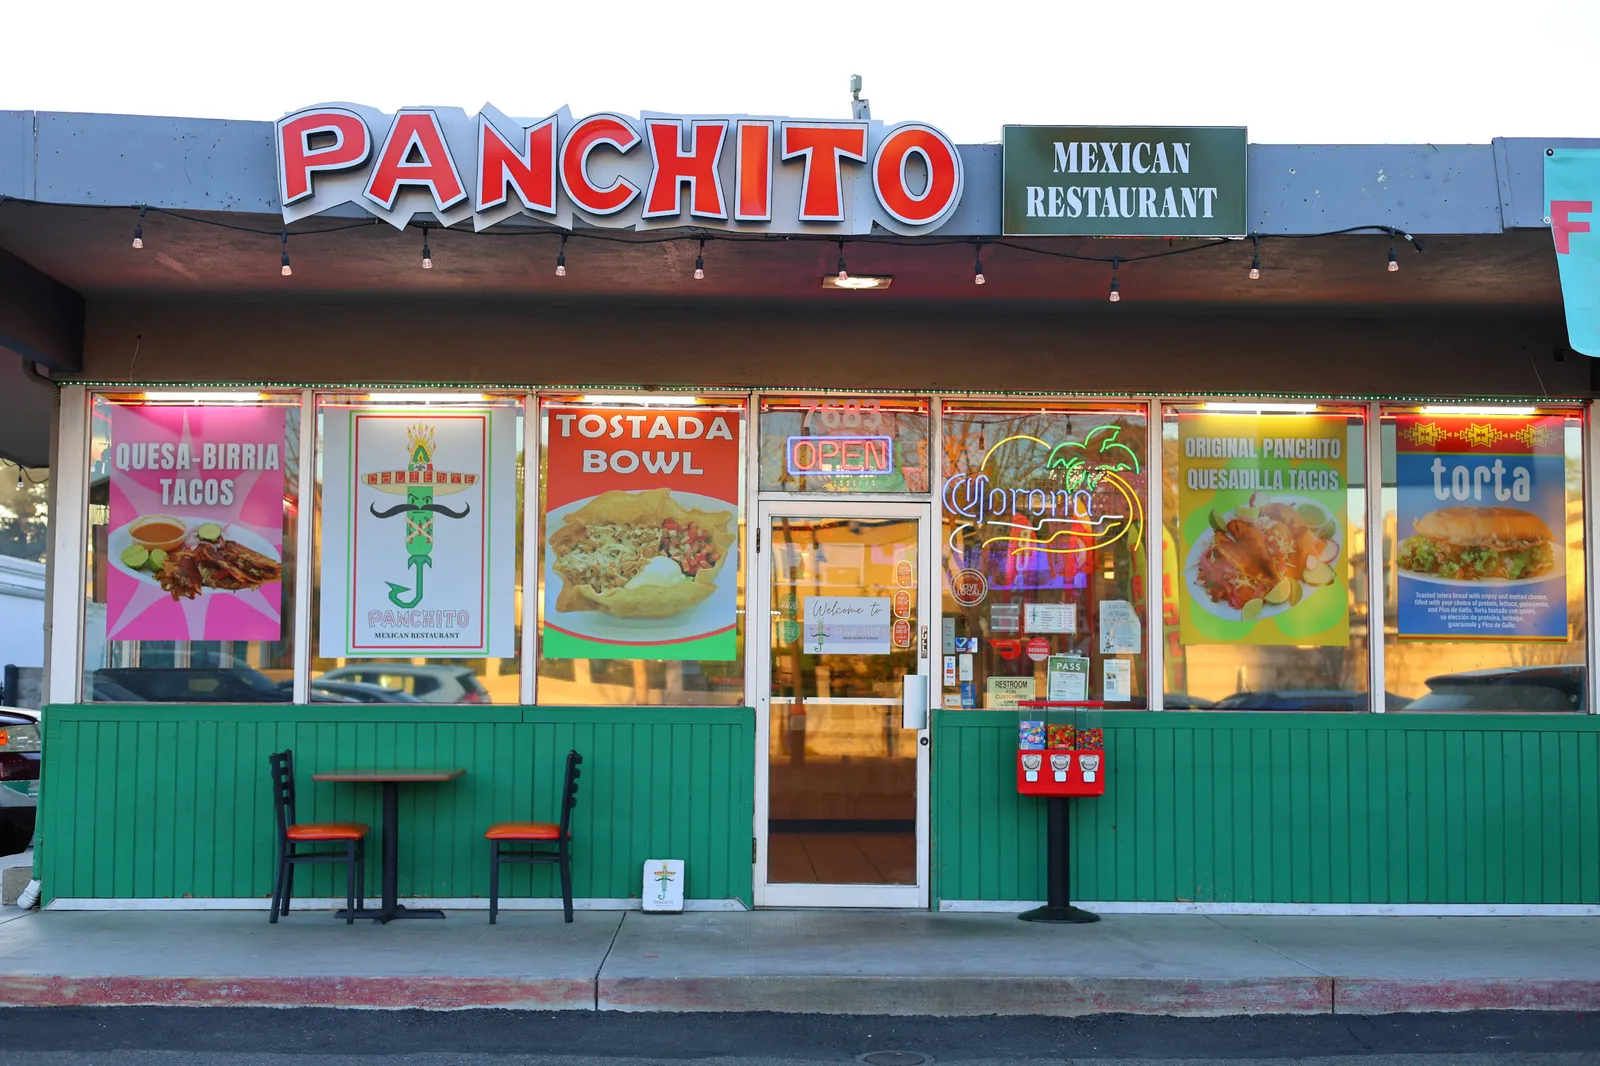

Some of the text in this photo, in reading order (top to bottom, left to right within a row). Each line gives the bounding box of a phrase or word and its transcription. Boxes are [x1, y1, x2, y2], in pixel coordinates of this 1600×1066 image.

[275, 105, 965, 227] PANCHITO
[1052, 141, 1191, 174] MEXICAN
[1025, 186, 1218, 218] RESTAURANT
[555, 413, 734, 441] TOSTADA
[115, 442, 280, 472] QUESA-BIRRIA
[582, 449, 704, 475] BOWL
[793, 440, 887, 471] OPEN
[1185, 437, 1341, 459] ORIGINAL PANCHITO
[159, 478, 235, 506] TACOS
[1187, 468, 1339, 491] QUESADILLA TACOS
[1430, 457, 1531, 502] torta
[942, 472, 1093, 524] Corona
[813, 599, 864, 617] Welcome
[870, 601, 882, 617] to
[1416, 591, 1436, 599] Toasted
[367, 609, 470, 628] PANCHITO
[1056, 662, 1081, 671] PASS
[994, 680, 1028, 689] RESTROOM
